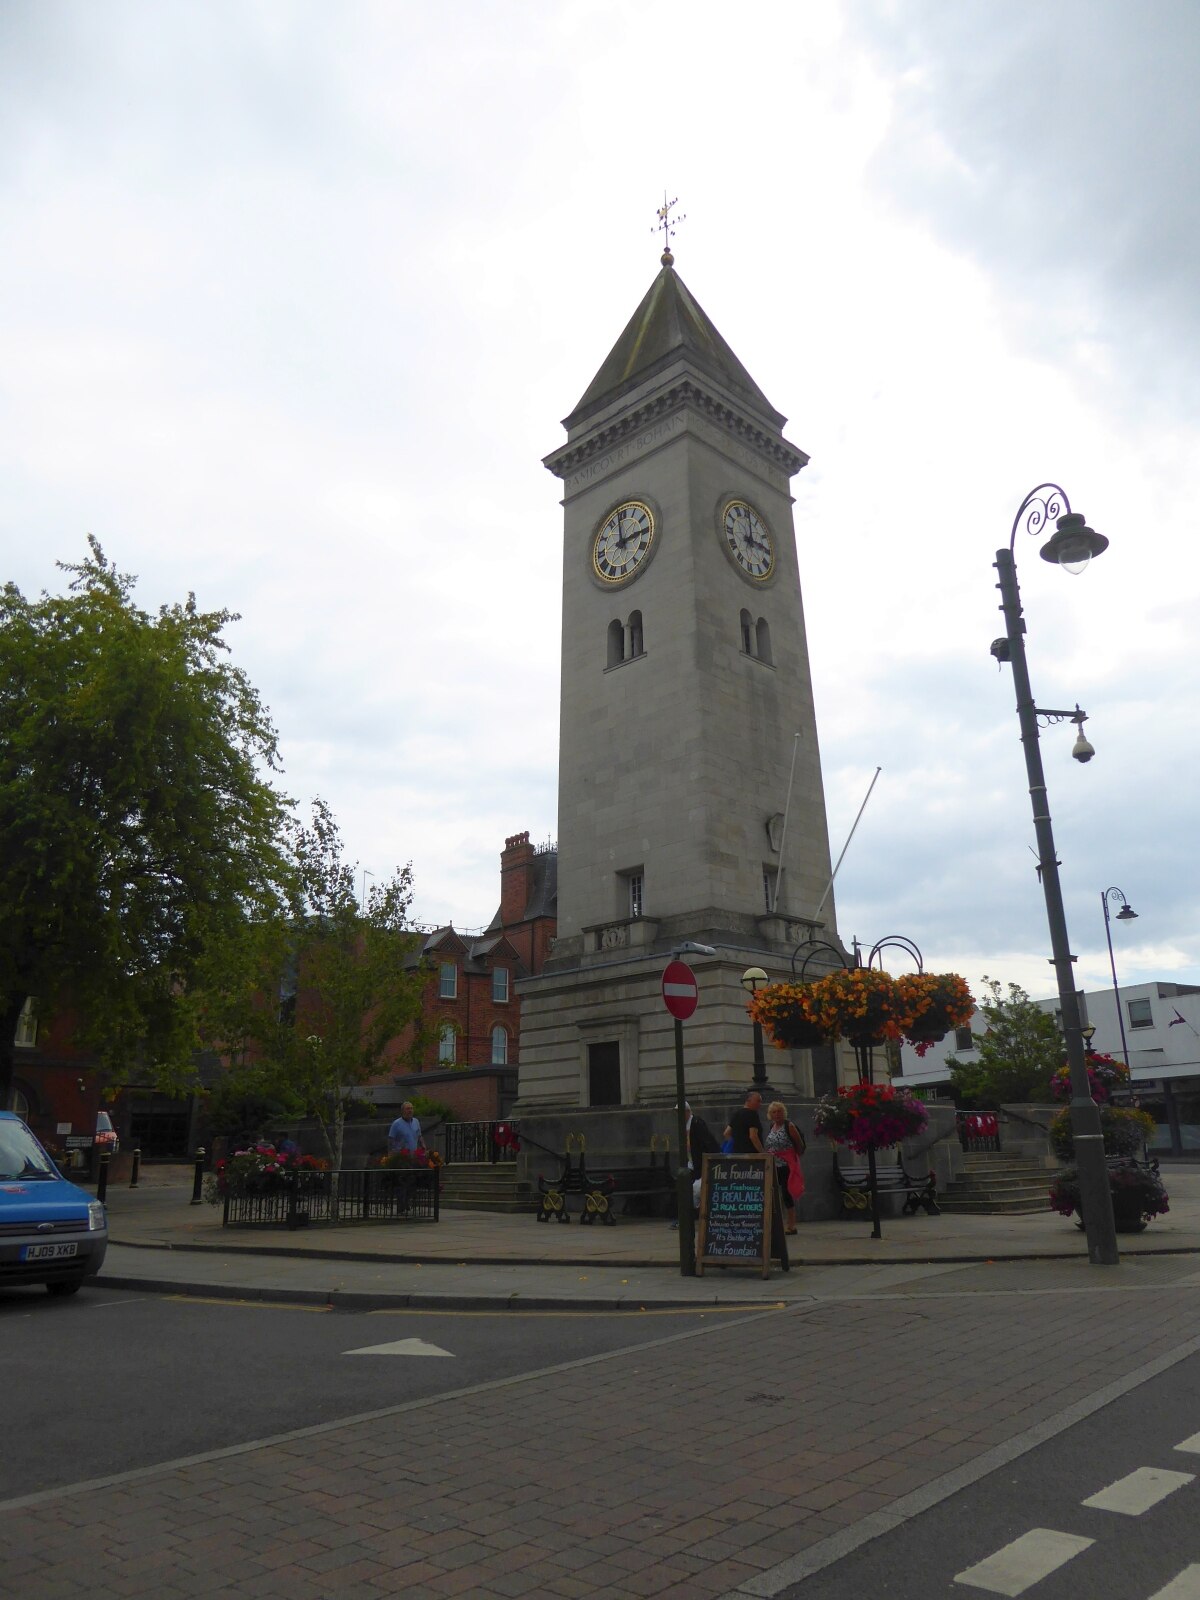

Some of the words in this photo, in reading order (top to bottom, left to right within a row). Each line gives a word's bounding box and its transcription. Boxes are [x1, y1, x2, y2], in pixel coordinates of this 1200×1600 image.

[712, 1164, 728, 1180] The
[730, 1164, 764, 1180] Fountain
[712, 1191, 720, 1203] 8
[721, 1191, 744, 1203] REAL
[744, 1191, 765, 1203] ALES
[711, 1203, 719, 1211] 2
[720, 1203, 737, 1211] REAL
[738, 1203, 763, 1212] CIDERS
[28, 1246, 55, 1258] HJ09
[56, 1244, 76, 1256] XKB
[709, 1241, 723, 1255] The
